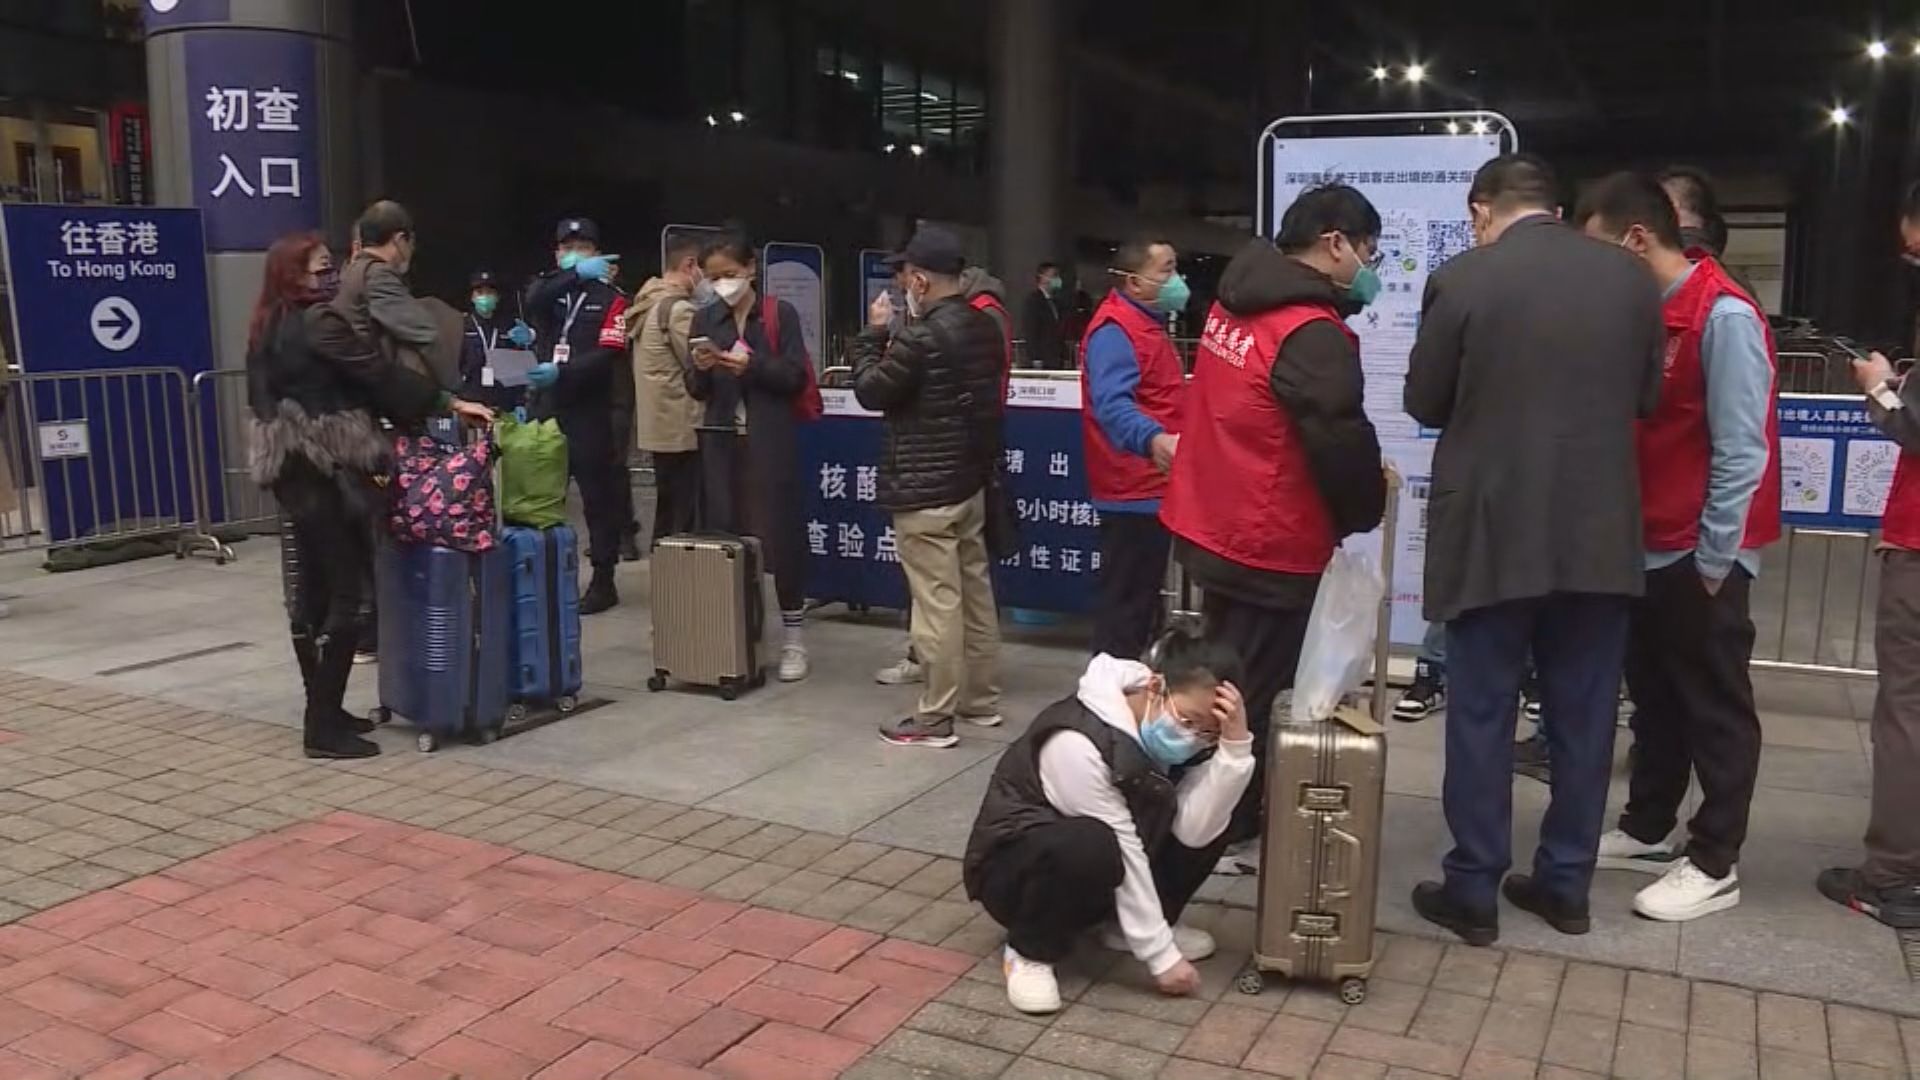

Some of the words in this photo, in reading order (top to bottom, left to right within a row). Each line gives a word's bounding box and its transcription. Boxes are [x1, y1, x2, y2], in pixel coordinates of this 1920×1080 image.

[206, 86, 300, 132] 初查
[210, 154, 301, 198] 入口
[60, 220, 159, 256] 往香港
[47, 260, 71, 278] To
[76, 260, 125, 281] Hong
[130, 260, 177, 280] Kong
[1017, 498, 1101, 527] 8小时核
